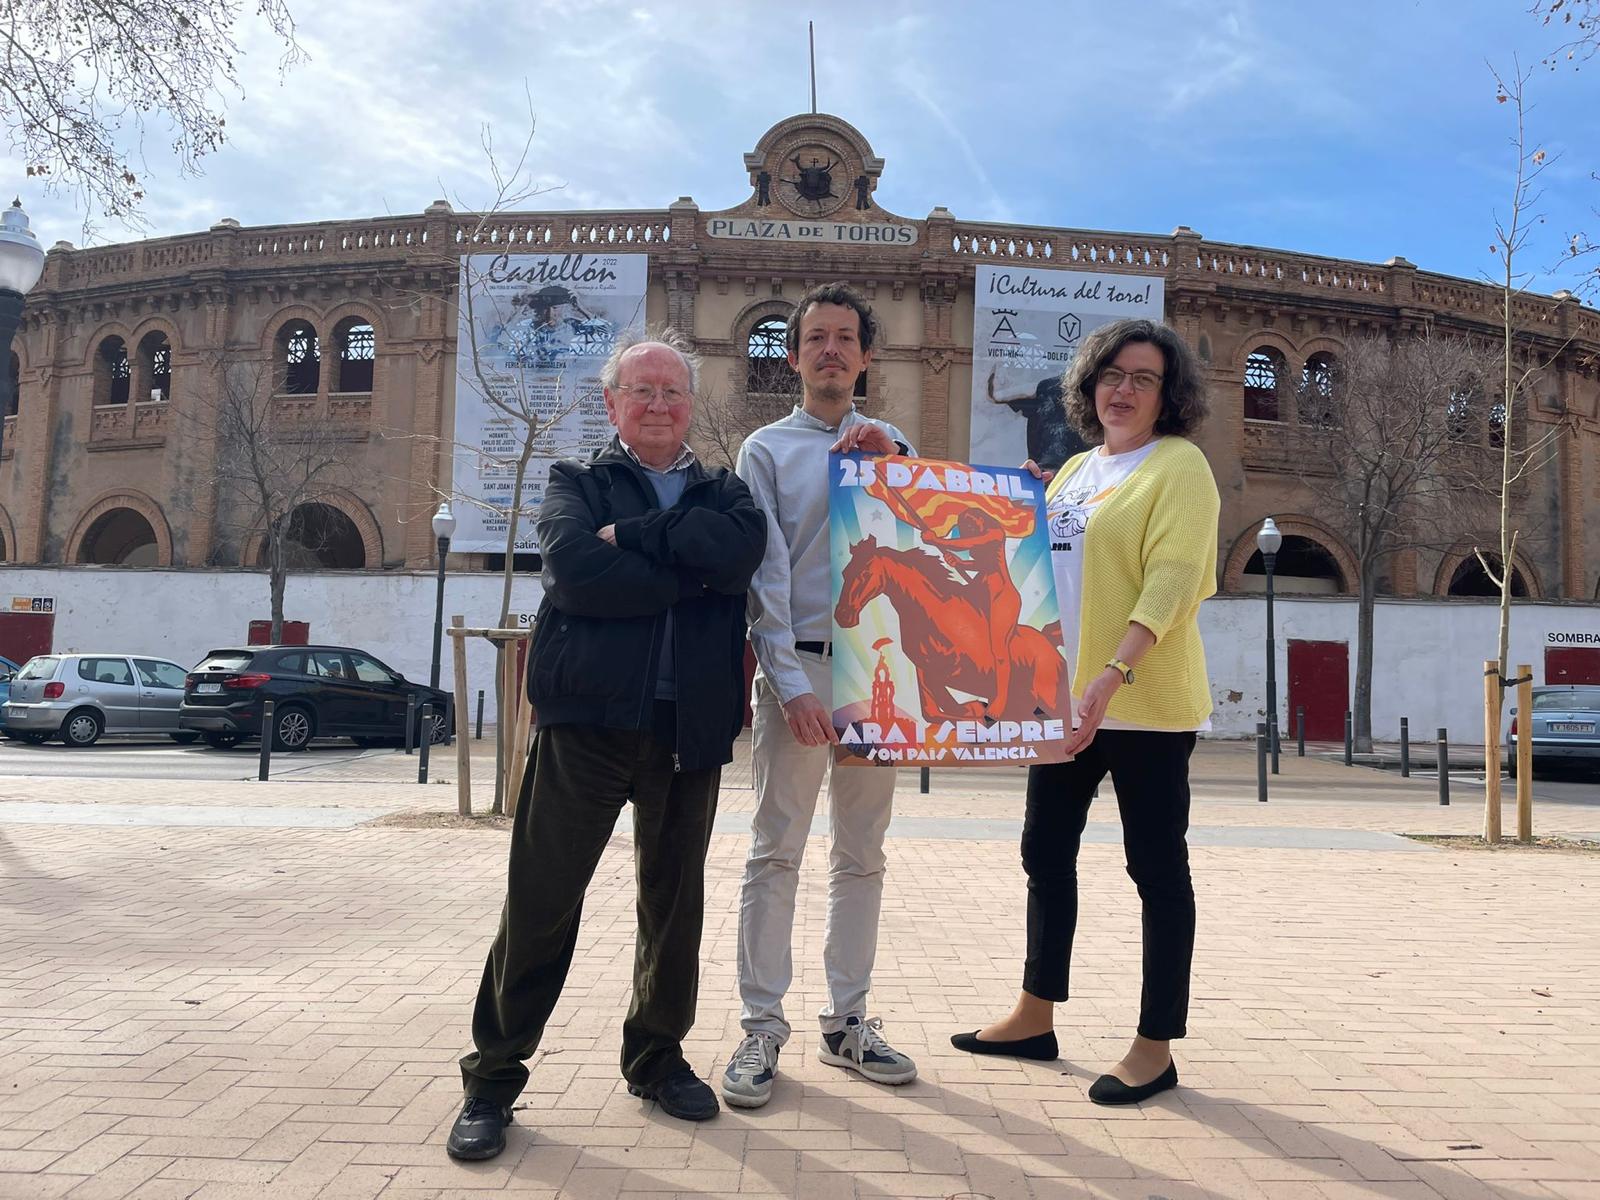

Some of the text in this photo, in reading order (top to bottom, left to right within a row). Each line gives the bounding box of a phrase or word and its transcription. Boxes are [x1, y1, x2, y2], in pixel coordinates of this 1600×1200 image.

[713, 220, 912, 243] PLAZA DE TOROS
[489, 254, 616, 284] Castellón
[602, 258, 618, 266] 2022
[990, 273, 1151, 304] ¡Cultura del toro!
[839, 459, 1035, 500] 25 D'ABRIL
[1547, 632, 1600, 643] SOMBRA
[839, 721, 908, 745] ARA
[933, 719, 1065, 744] SEMPRE
[866, 747, 903, 761] SOM
